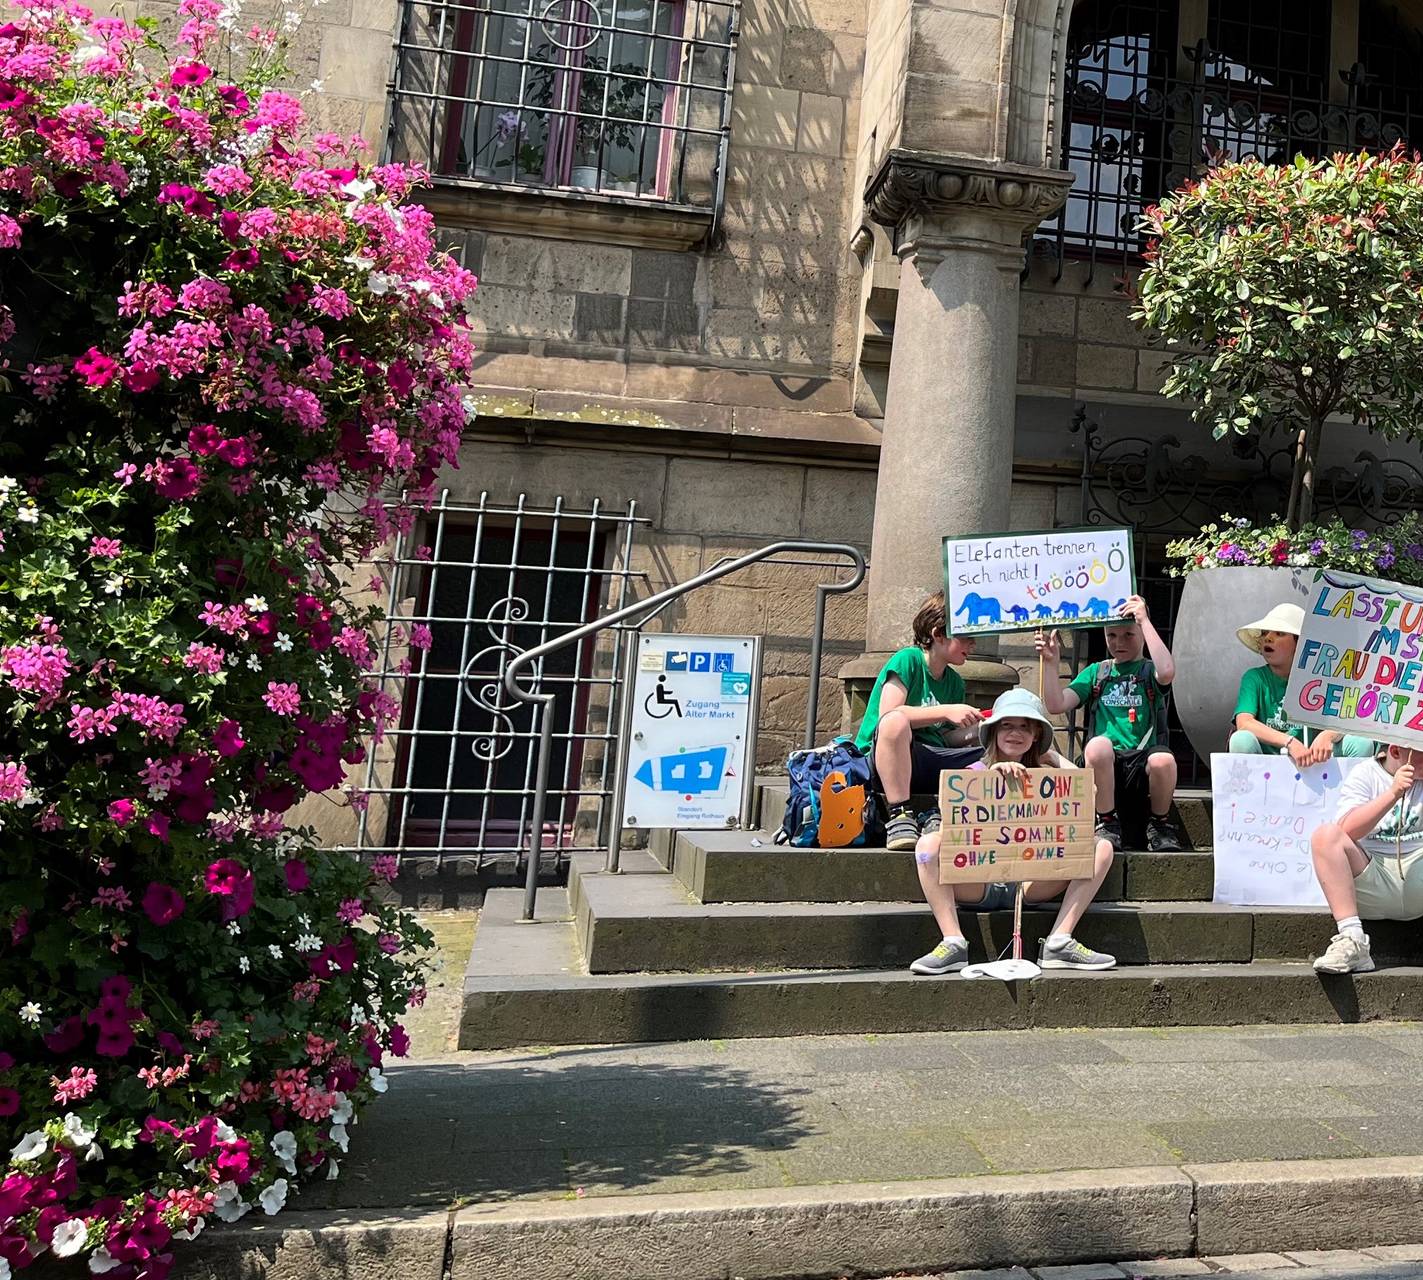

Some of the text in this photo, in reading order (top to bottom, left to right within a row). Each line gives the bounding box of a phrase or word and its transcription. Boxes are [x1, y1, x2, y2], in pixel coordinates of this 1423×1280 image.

[954, 536, 1097, 563] Elefanten trennen
[958, 566, 991, 587] sich
[1312, 586, 1400, 625] LASST
[1363, 625, 1400, 656] IM
[1298, 639, 1371, 681] FRAU
[685, 700, 720, 710] Zugang
[1299, 679, 1411, 725] GEHÖRT
[685, 711, 735, 719] Alter Markt
[1039, 775, 1085, 799] OHNE
[1055, 802, 1081, 817] IST
[950, 825, 1076, 846] WIE SOMMER
[953, 847, 1065, 868] OHNE ONNE
